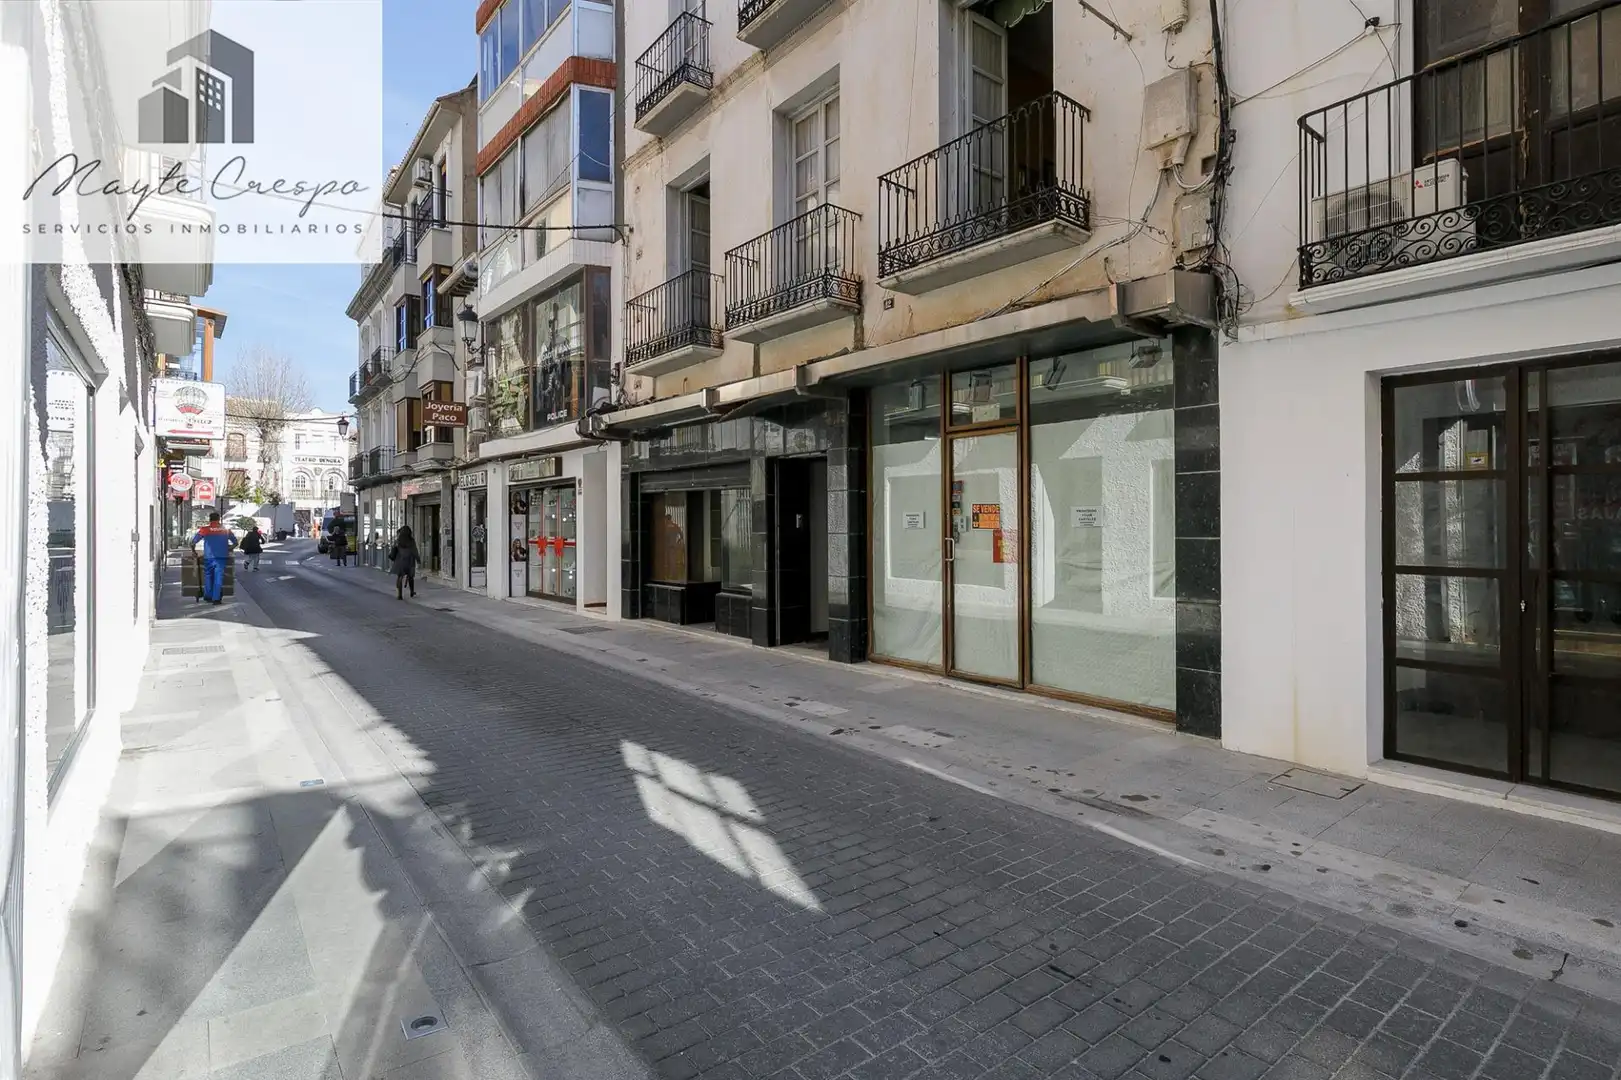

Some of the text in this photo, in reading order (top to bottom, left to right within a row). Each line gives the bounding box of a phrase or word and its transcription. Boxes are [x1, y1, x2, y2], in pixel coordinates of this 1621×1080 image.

[432, 412, 457, 421] Paco
[547, 409, 568, 420] POLICE
[972, 504, 1000, 513] SE VENDE
